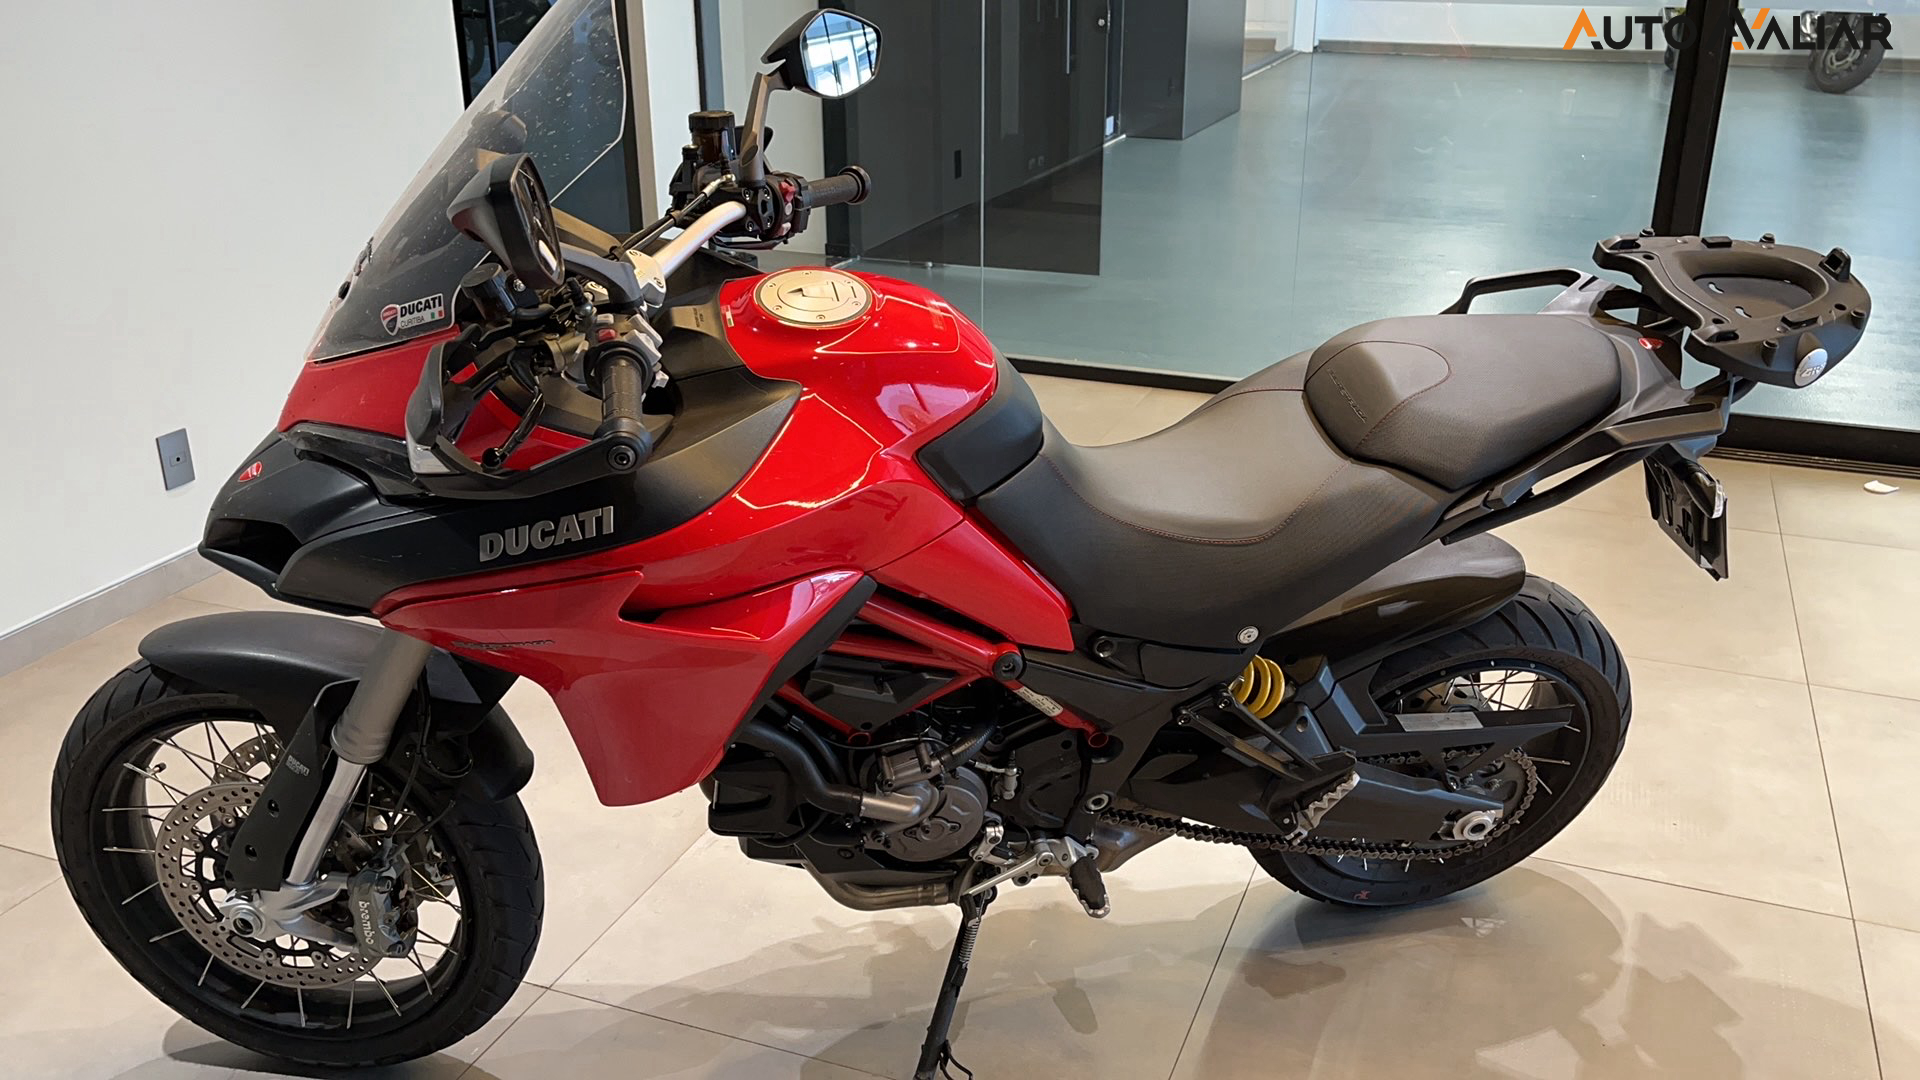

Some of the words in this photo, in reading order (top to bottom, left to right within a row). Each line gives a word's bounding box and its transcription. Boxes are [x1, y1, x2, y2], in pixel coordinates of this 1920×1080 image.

[400, 296, 442, 317] DUCATI
[400, 316, 425, 328] CURITIBA
[479, 505, 614, 562] DUCATI
[358, 900, 375, 945] brembo
